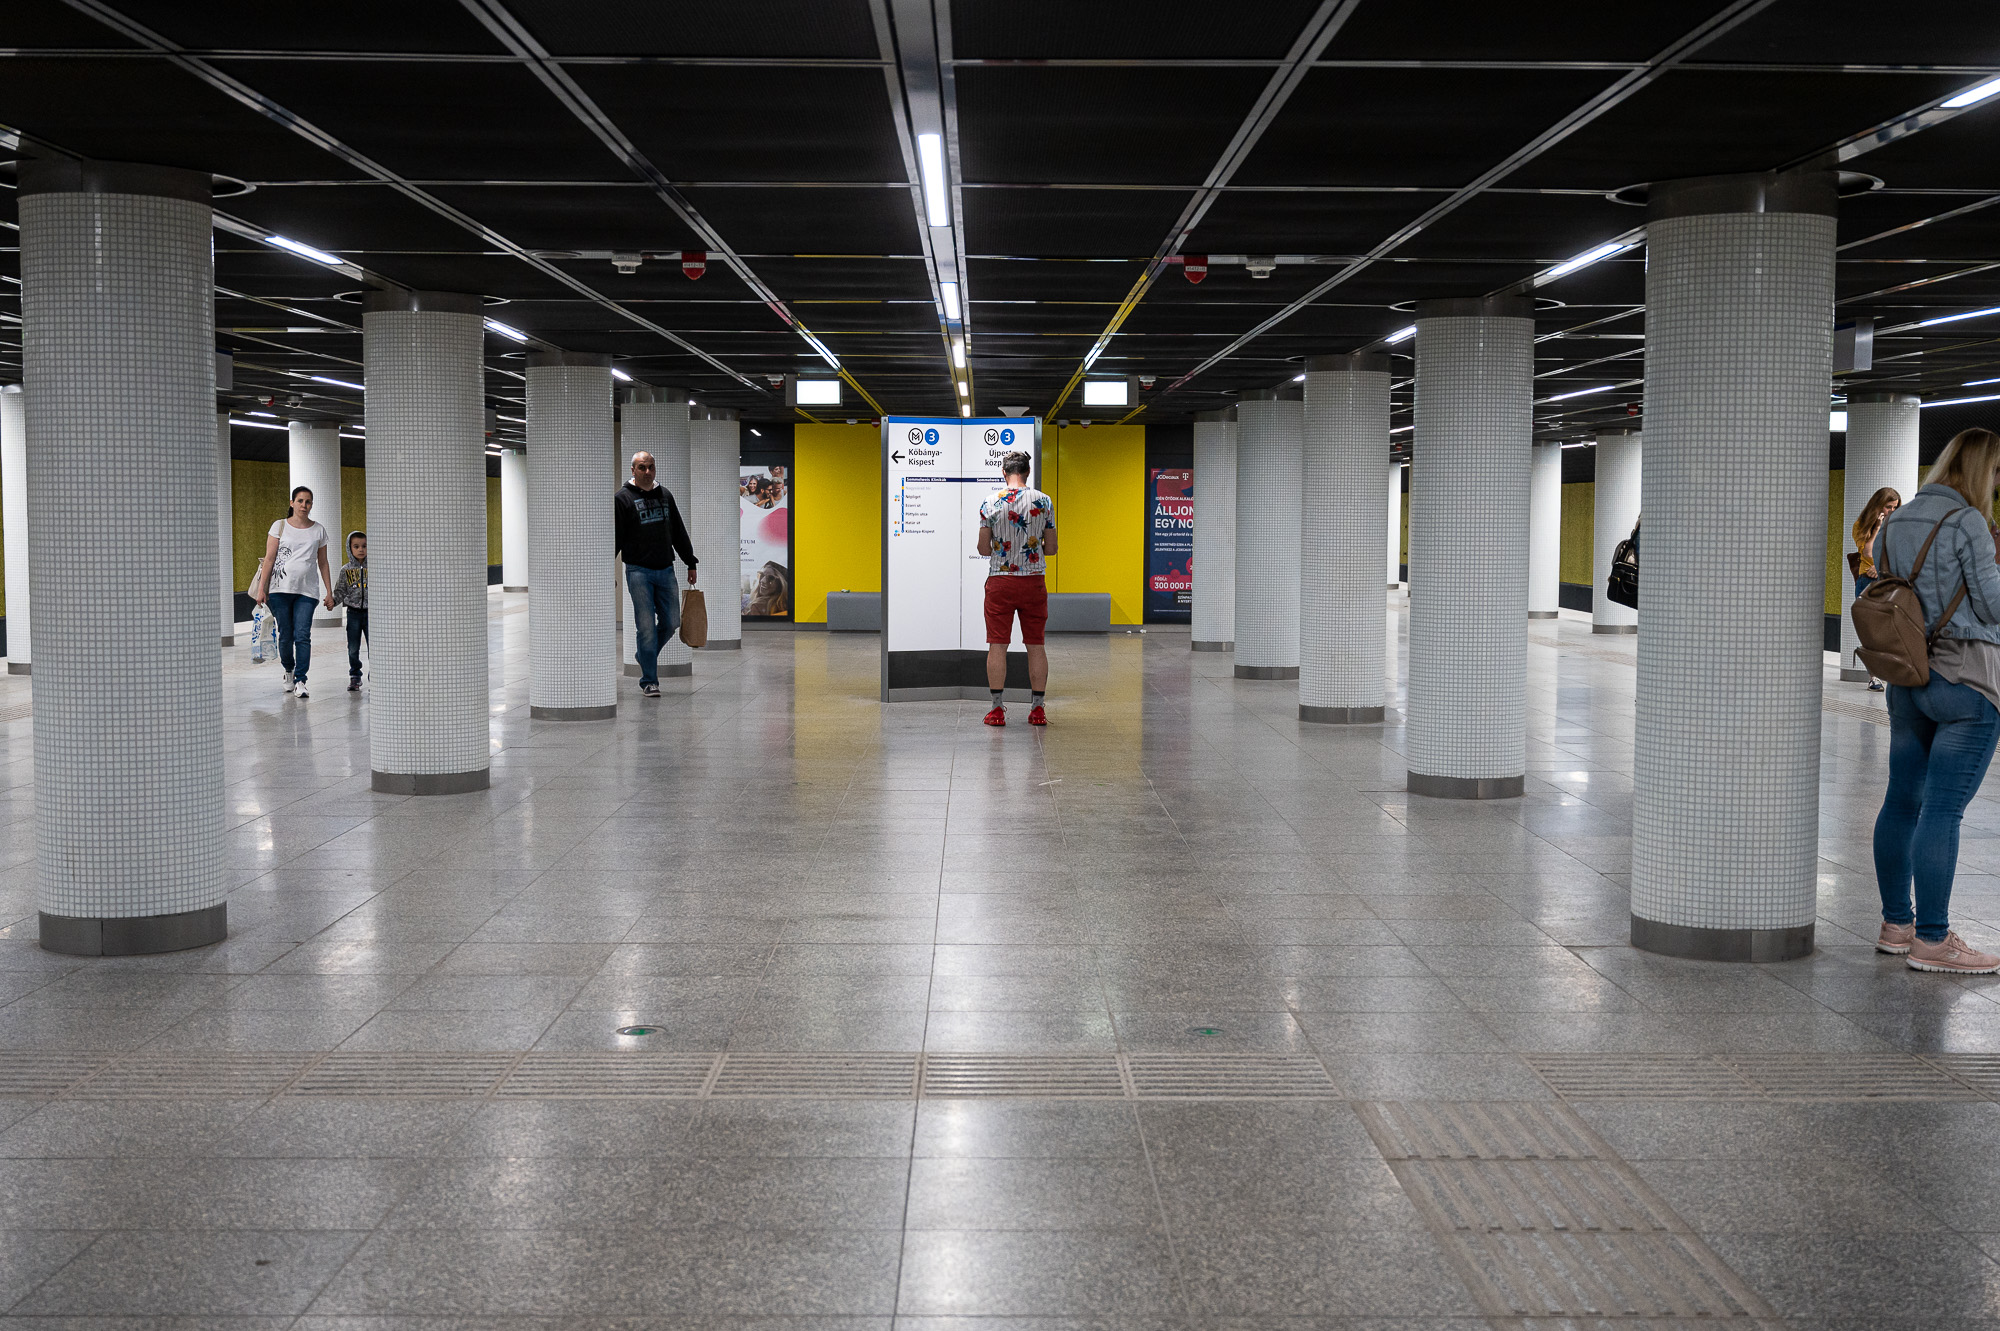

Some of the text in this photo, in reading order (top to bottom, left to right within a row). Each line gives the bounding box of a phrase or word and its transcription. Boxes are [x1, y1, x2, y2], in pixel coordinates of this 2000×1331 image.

[928, 431, 936, 442] 3
[1004, 431, 1012, 443] 3
[908, 448, 943, 458] Kőbánya-
[908, 458, 935, 467] Kispest
[1155, 518, 1176, 529] EGY
[1154, 582, 1169, 590] 300
[1170, 582, 1184, 590] 000
